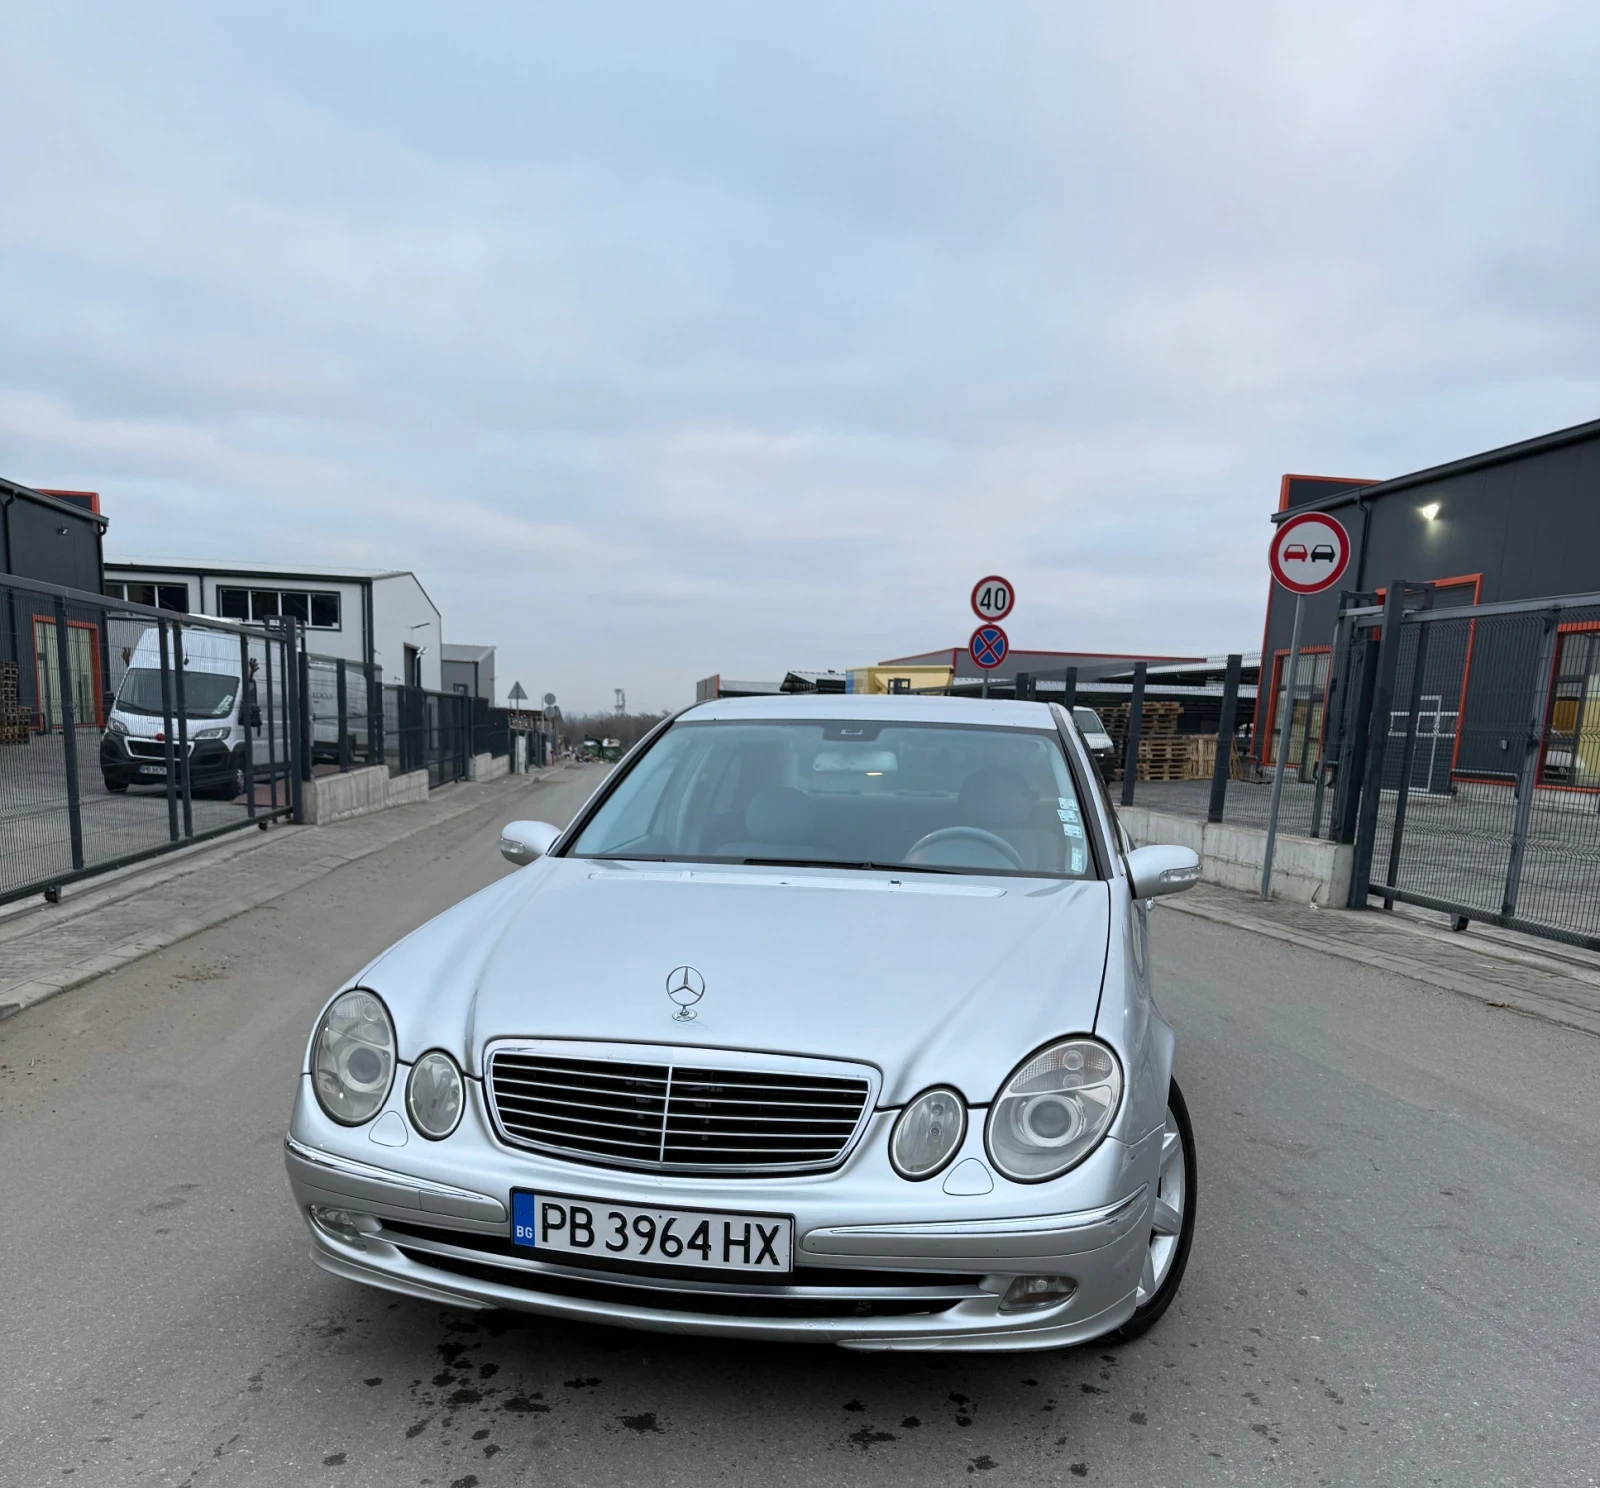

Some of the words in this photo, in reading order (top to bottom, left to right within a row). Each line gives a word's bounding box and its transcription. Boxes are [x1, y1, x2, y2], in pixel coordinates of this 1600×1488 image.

[980, 587, 1006, 610] 40
[516, 1225, 533, 1239] BG
[541, 1202, 595, 1248] PB
[605, 1211, 712, 1261] 3964
[723, 1221, 781, 1266] HX
